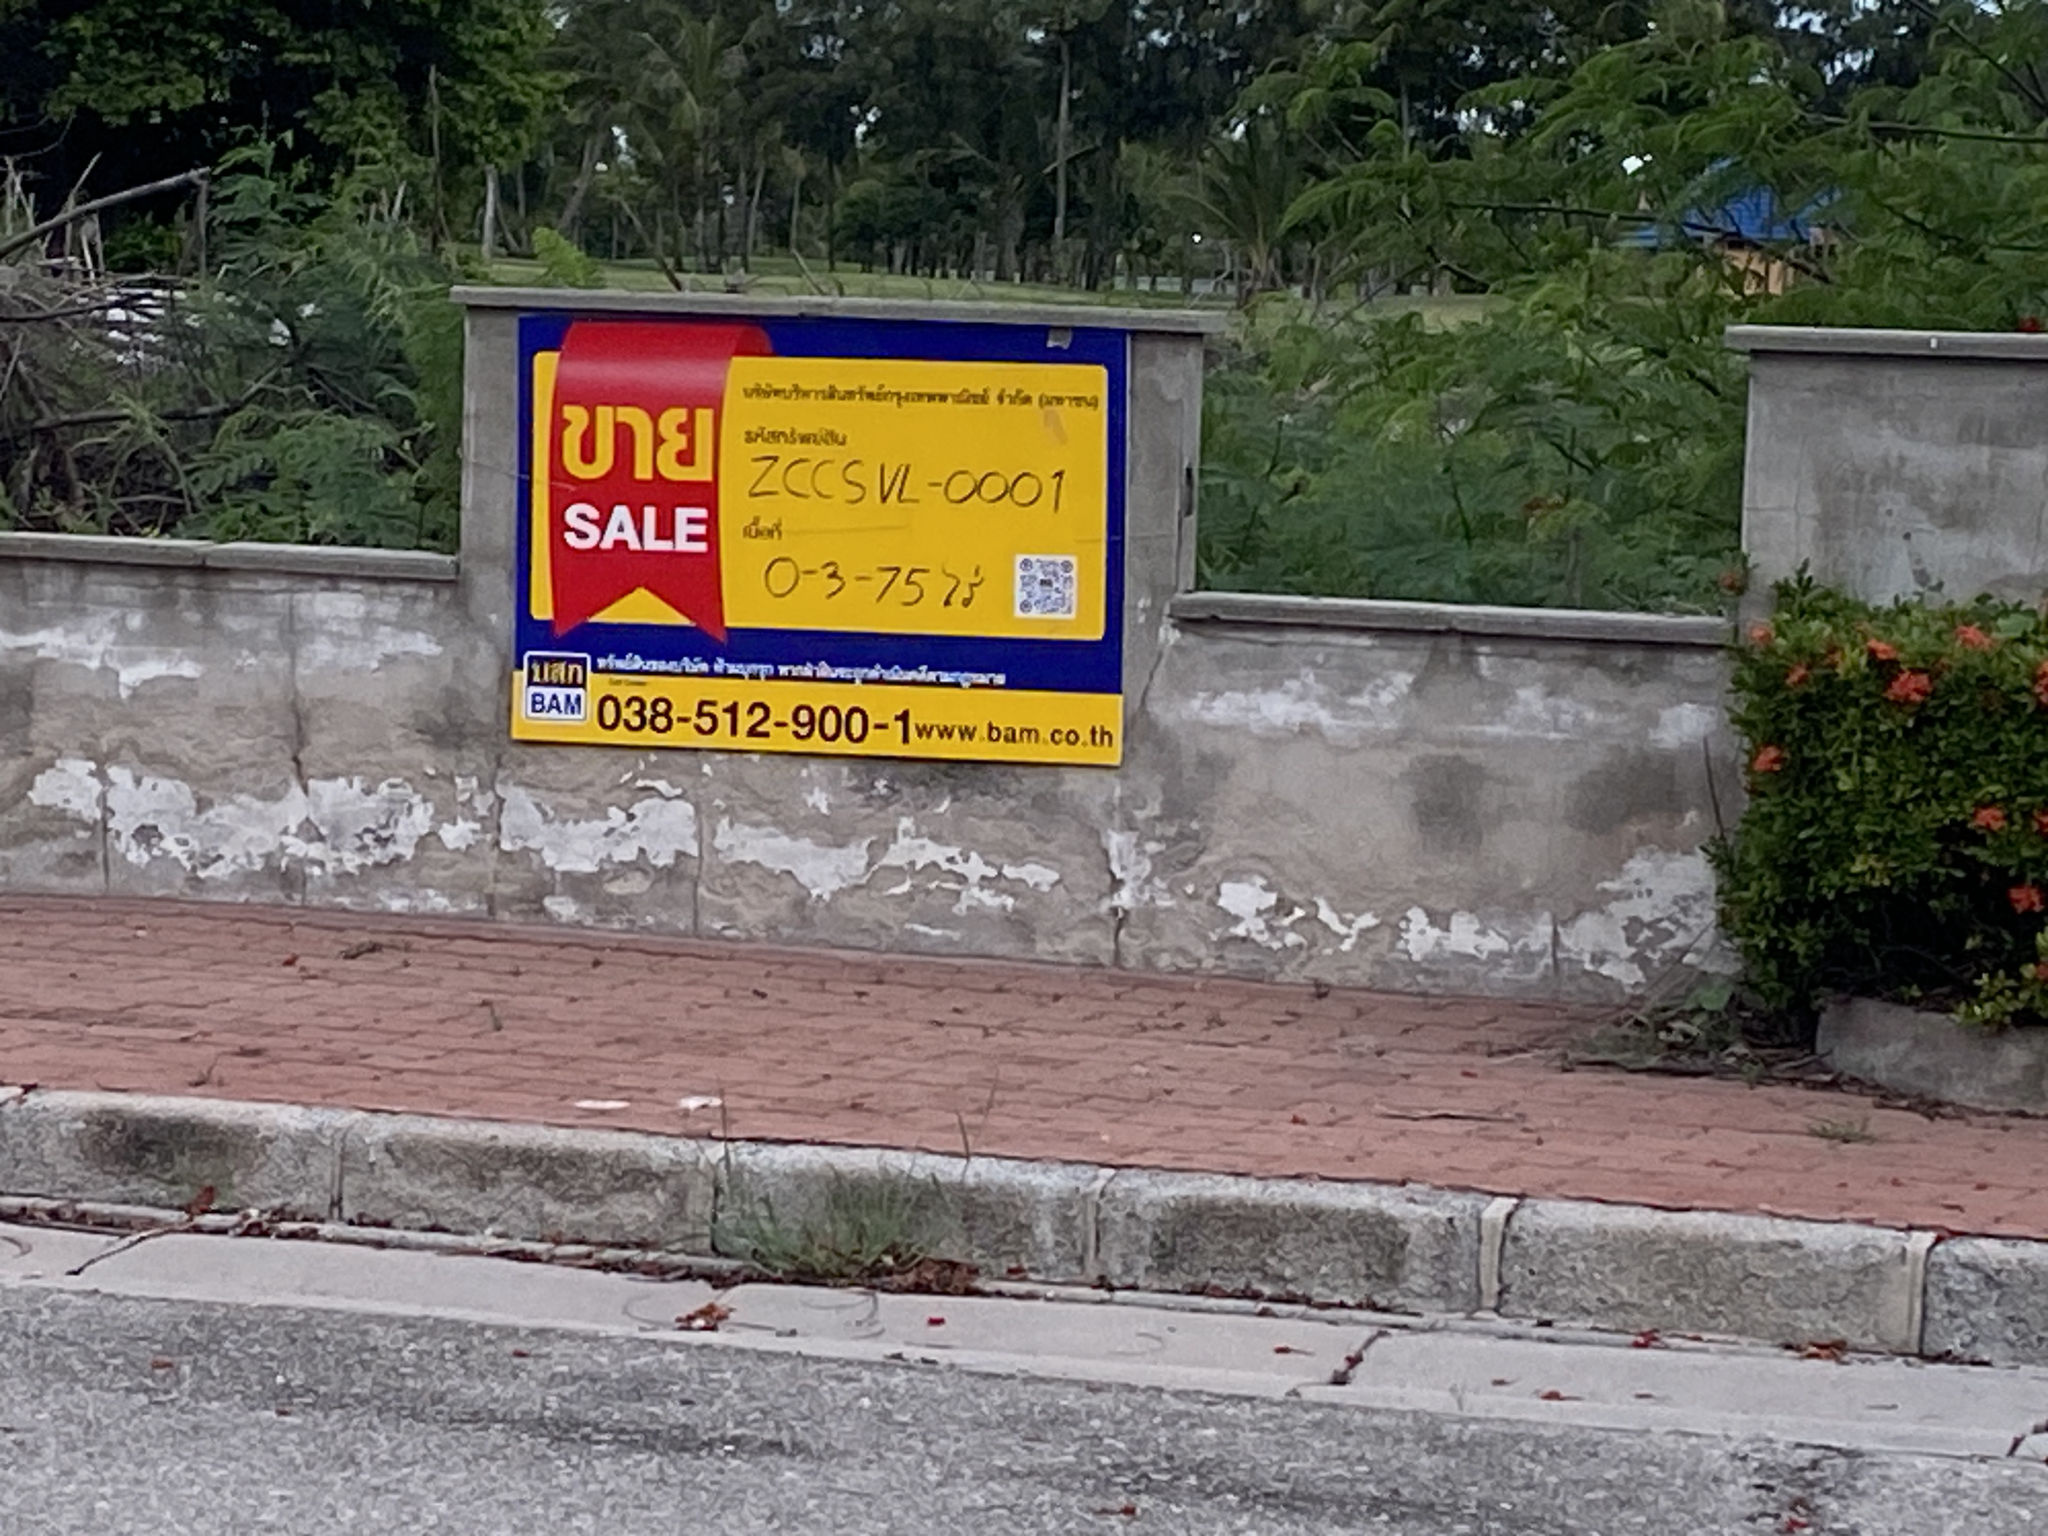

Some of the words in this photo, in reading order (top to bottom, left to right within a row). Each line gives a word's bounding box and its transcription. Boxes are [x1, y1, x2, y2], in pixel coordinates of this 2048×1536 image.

[561, 404, 713, 481] ขาย
[563, 503, 708, 552] SALE
[531, 691, 583, 715] BAM
[597, 693, 911, 745] 038-512-900-1
[913, 720, 1114, 748] www.bam.co.th
